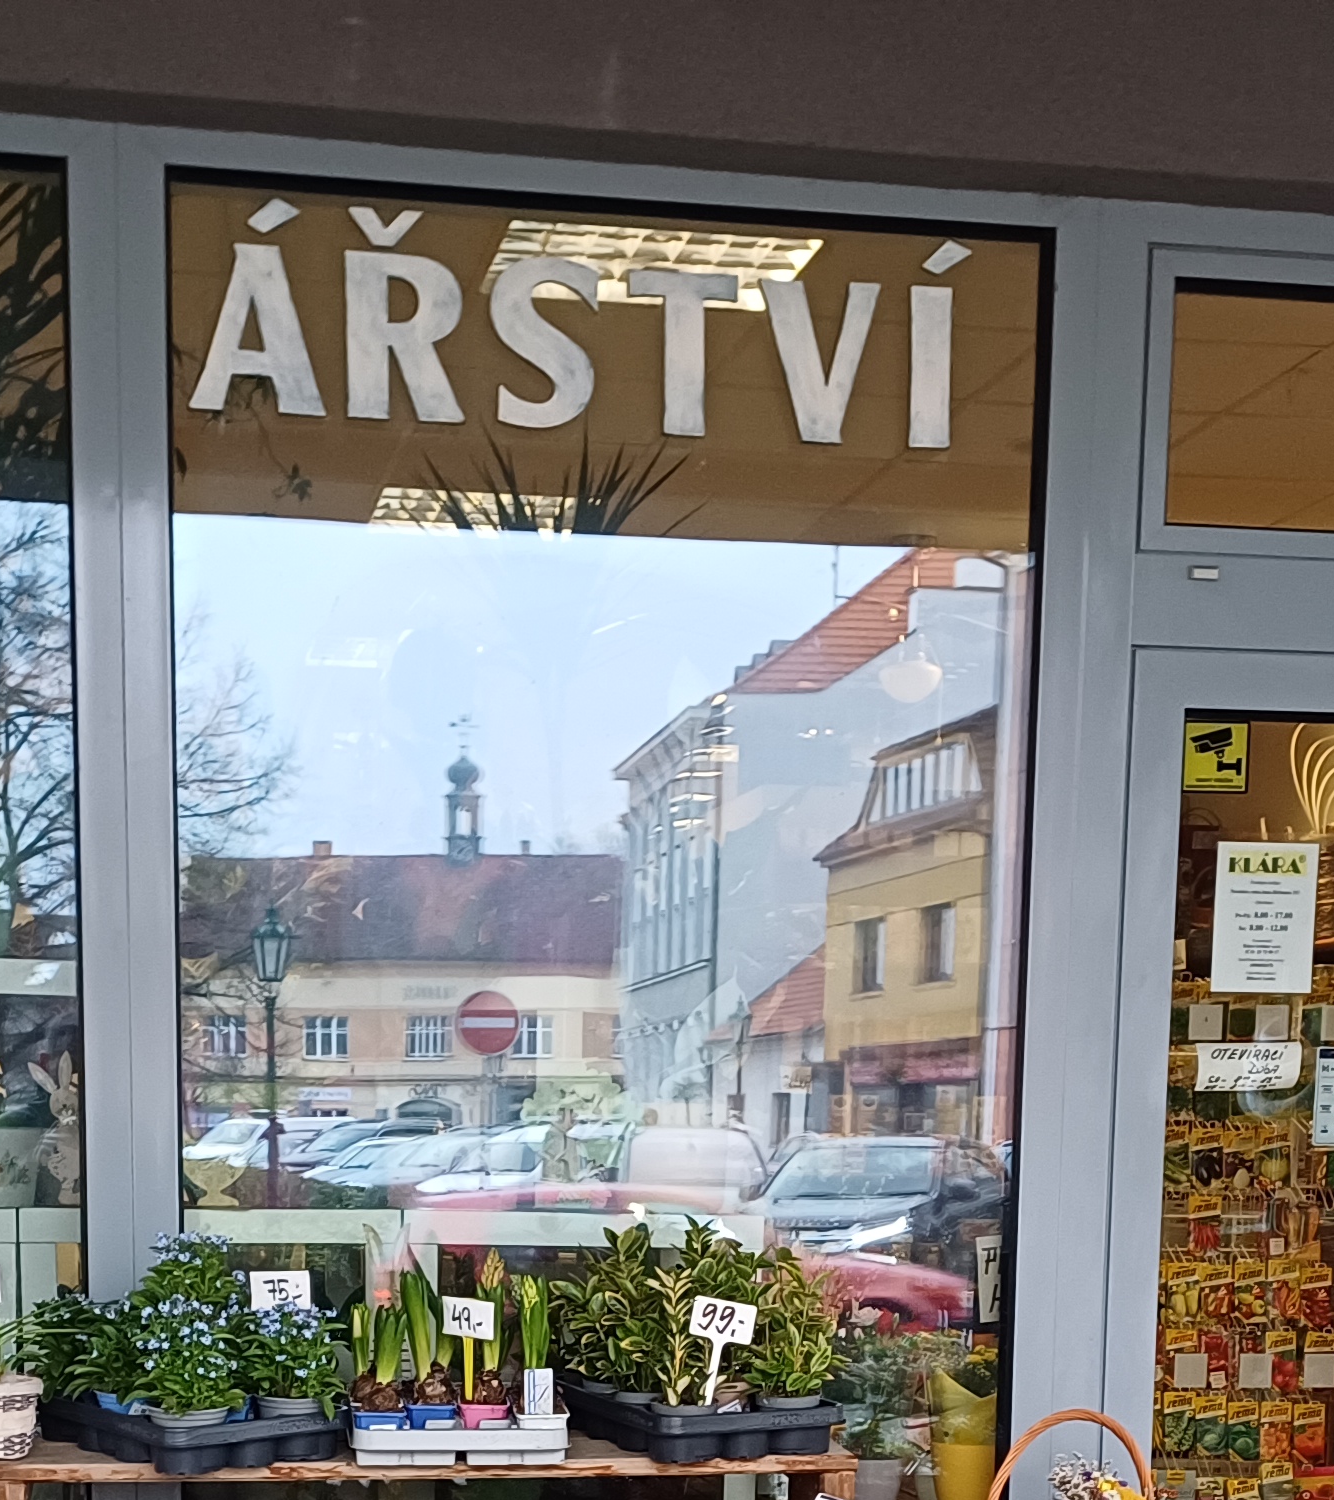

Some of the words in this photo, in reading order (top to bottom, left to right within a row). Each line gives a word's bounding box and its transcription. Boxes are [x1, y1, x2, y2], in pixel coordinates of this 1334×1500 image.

[188, 198, 973, 449] ÁŘSTVÍ
[452, 1303, 483, 1334] 49,-
[697, 1302, 745, 1337] 99,-
